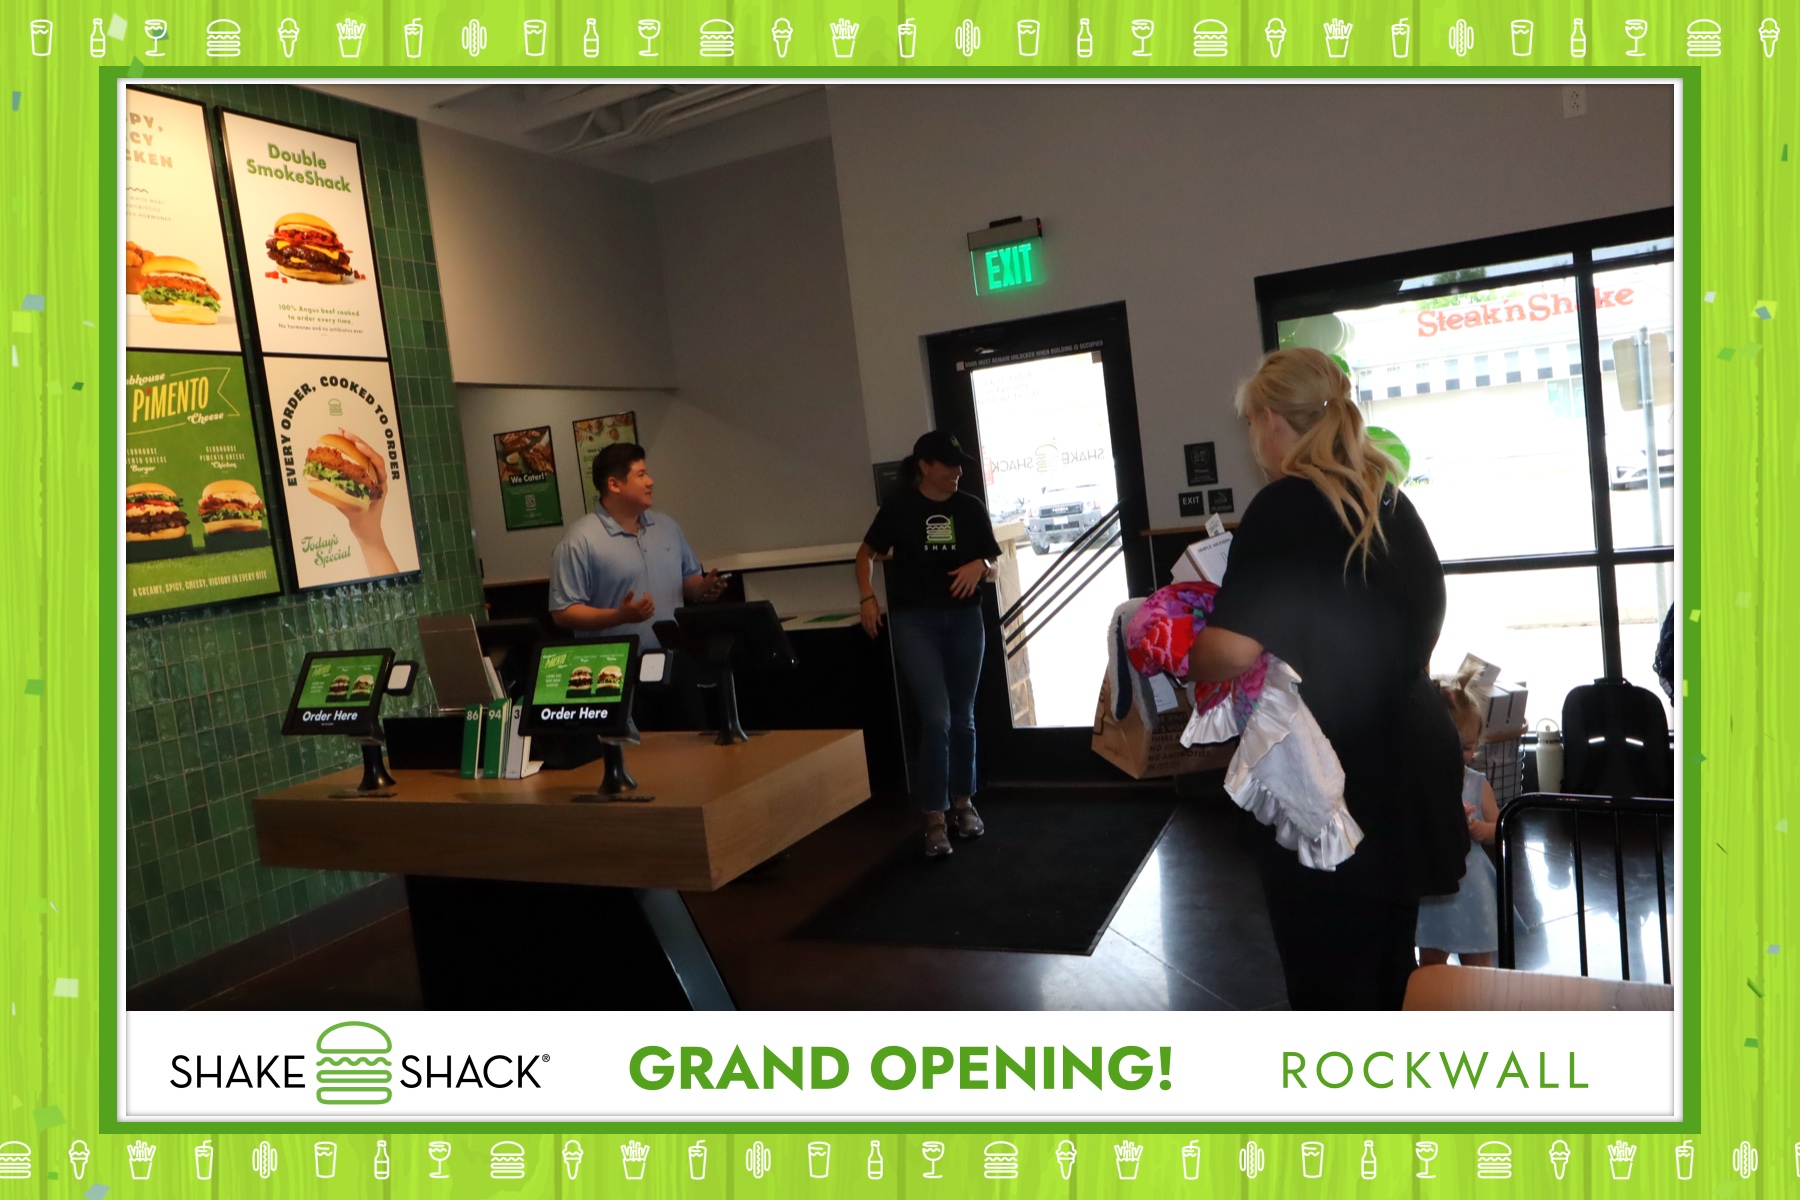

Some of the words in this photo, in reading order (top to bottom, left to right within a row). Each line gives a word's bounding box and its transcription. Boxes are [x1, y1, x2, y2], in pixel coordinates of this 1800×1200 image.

[268, 142, 327, 169] Double
[246, 158, 352, 193] SmokeShack
[985, 242, 1032, 290] EXIT
[278, 304, 297, 312] 100%
[299, 305, 320, 315] Angus
[321, 307, 336, 315] beef
[337, 309, 360, 317] cooked
[1528, 287, 1635, 323] Shke
[317, 317, 336, 325] every
[965, 360, 978, 368] DOOR
[978, 358, 991, 366] MUST
[992, 355, 1010, 364] REMAIN
[1011, 351, 1035, 361] UNLOCKED
[1036, 348, 1050, 357] WHEN
[1051, 345, 1073, 355] BUILDING
[1073, 343, 1079, 351] IS
[1079, 340, 1104, 350] OCCUPIED
[320, 375, 376, 406] COOKED
[281, 382, 317, 431] ORDER,
[187, 412, 225, 425] Cheese
[374, 404, 389, 425] TO
[126, 457, 143, 465] ENTO
[199, 453, 224, 462] PIMENTO
[280, 434, 298, 487] EVERY
[384, 428, 401, 481] ORDER
[130, 464, 156, 475] Burger
[210, 461, 237, 469] Chicken
[510, 475, 523, 484] We
[523, 472, 545, 483] Cater!
[1182, 496, 1200, 506] EXIT
[301, 533, 339, 554] Today's
[314, 545, 351, 569] Special
[132, 587, 138, 597] A
[138, 586, 165, 597] CREAMY,
[165, 582, 185, 593] SPICY,
[185, 578, 209, 590] CHEESY,
[208, 576, 232, 587] VICTORY
[231, 575, 239, 584] IN
[239, 573, 256, 583] EVERY
[255, 570, 268, 580] BITE
[302, 709, 332, 722] Order
[333, 709, 359, 721] Here
[466, 710, 479, 721] 86
[488, 709, 502, 720] 94
[541, 706, 576, 721] Order
[579, 706, 609, 719] Here
[1150, 744, 1162, 752] NO
[1148, 754, 1160, 762] NO
[1162, 750, 1211, 760] ANTIBIOTICS
